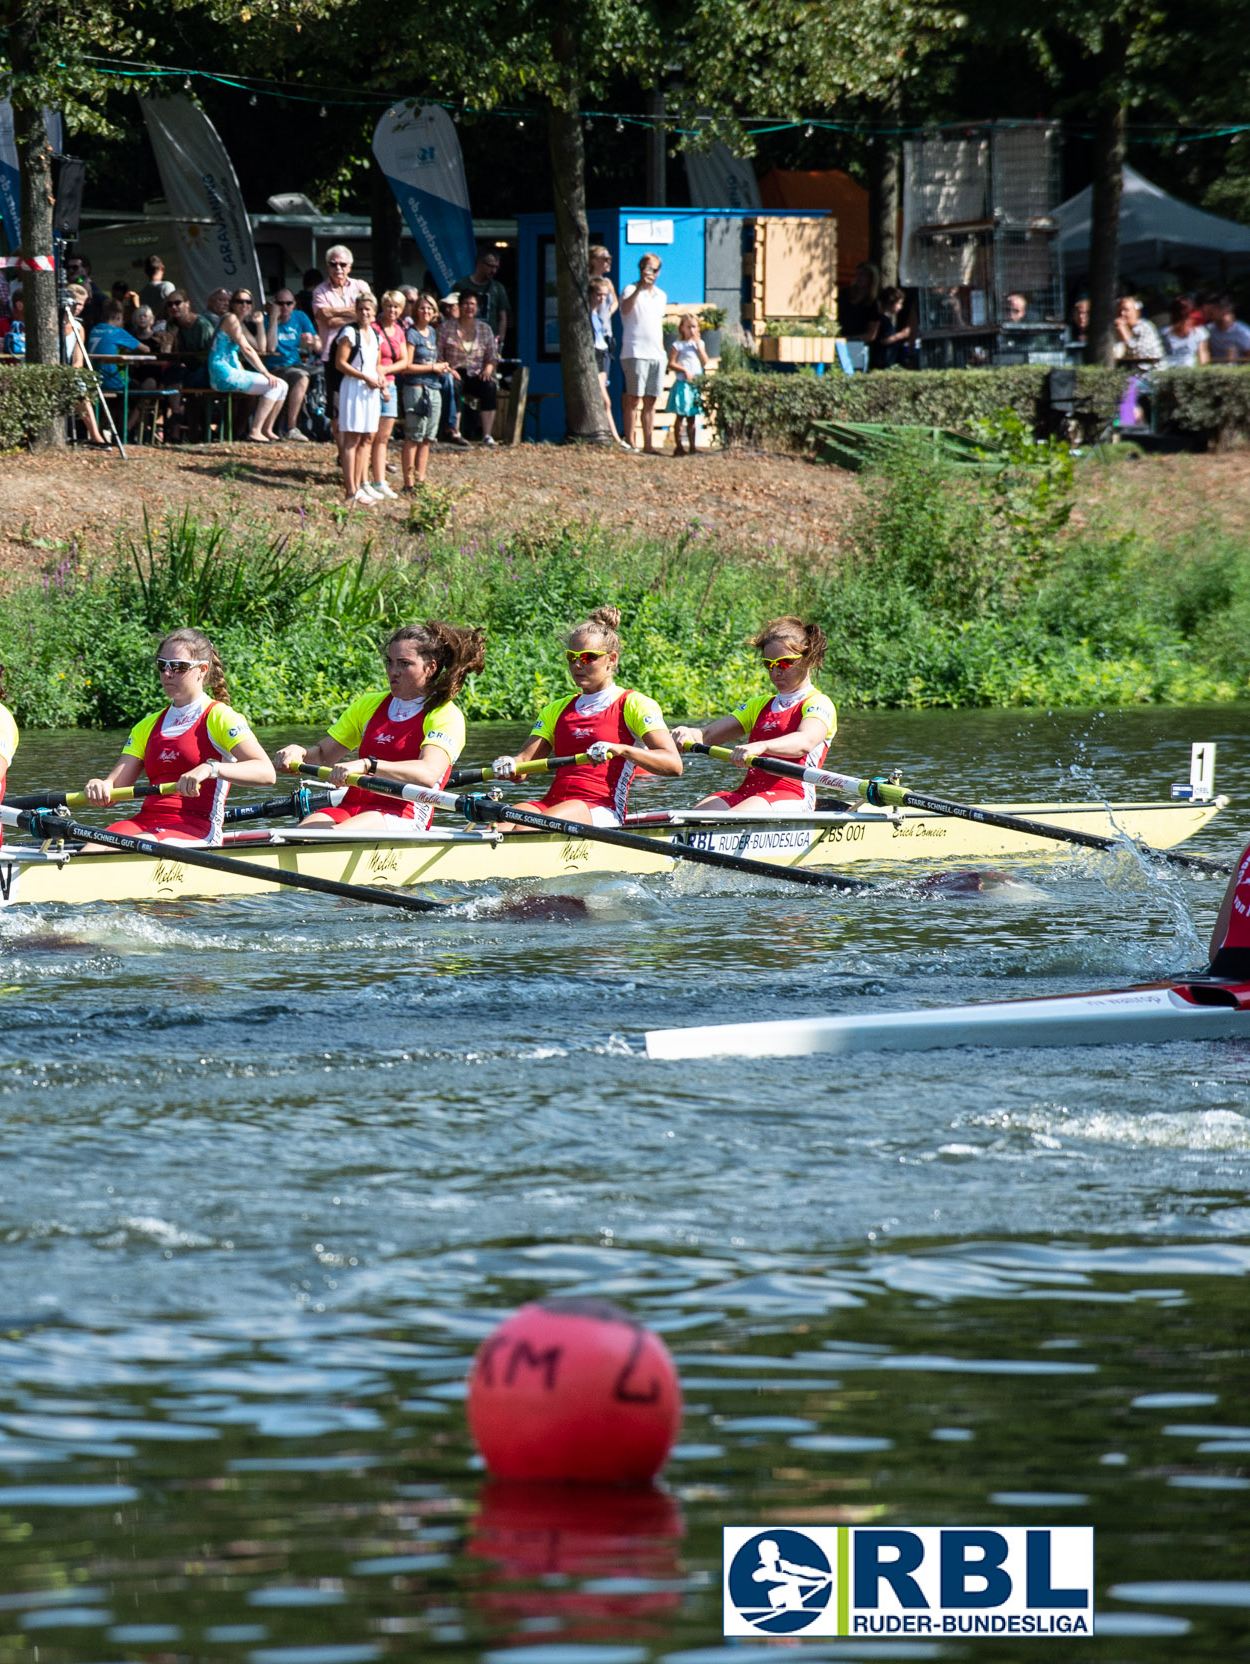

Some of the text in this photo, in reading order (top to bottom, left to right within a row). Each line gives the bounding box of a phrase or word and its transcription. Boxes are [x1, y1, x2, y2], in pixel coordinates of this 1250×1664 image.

[1197, 748, 1204, 781] 1
[818, 774, 844, 789] Melitta
[416, 791, 442, 804] Melitta
[907, 797, 927, 809] STARK.
[928, 801, 952, 814] SCHNELL.
[953, 808, 967, 818] GUT.
[505, 810, 523, 821] STARK.
[523, 815, 548, 828] SCHNELL.
[548, 821, 562, 830] GUT.
[73, 827, 92, 840] STARK.
[93, 831, 120, 846] SCHNELL.
[120, 838, 135, 849] GUT.
[829, 826, 843, 843] BS
[846, 824, 865, 841] 001
[892, 823, 947, 838] Erich Domeier
[687, 832, 810, 852] RBL RUDER-BUNDESLIGA
[367, 845, 398, 872] Melitta
